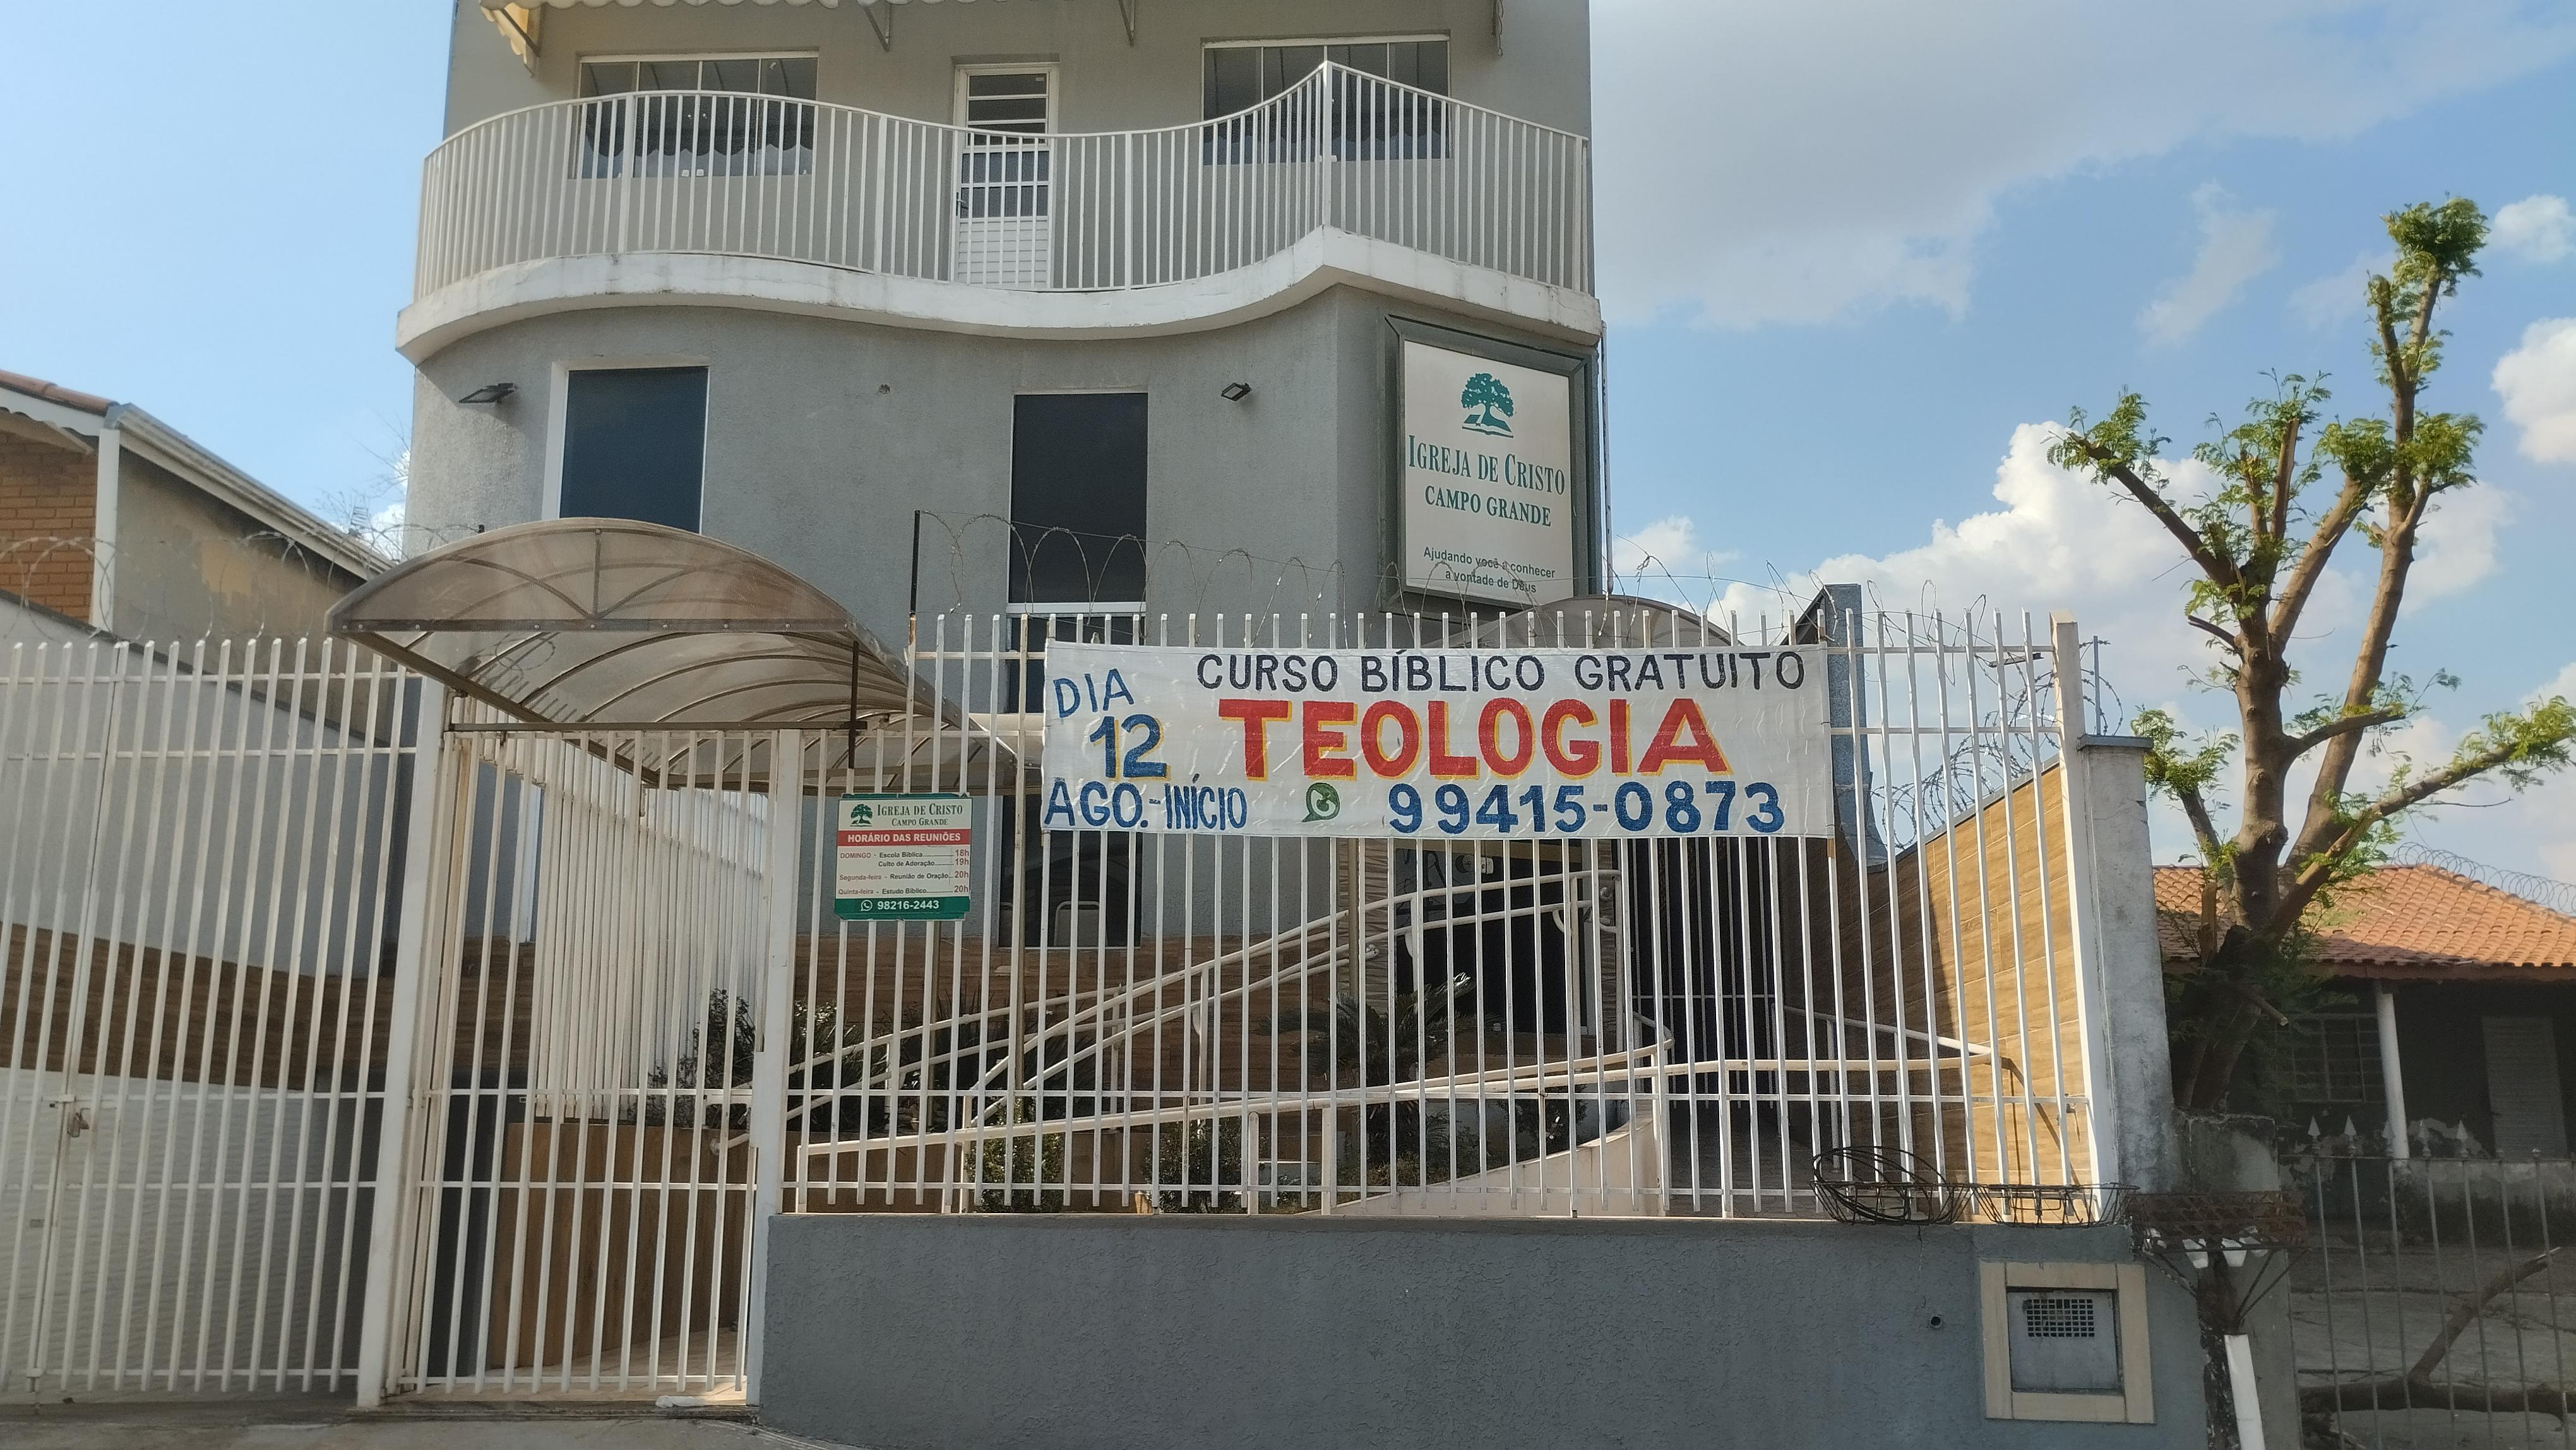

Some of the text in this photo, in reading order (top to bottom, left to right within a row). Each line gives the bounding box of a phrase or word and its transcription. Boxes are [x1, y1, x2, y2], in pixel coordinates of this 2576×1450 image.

[1409, 434, 1565, 495] IGREJA DE CRISTO
[1425, 485, 1551, 527] CAMPO GRANDE
[1424, 546, 1472, 564] Ajudando
[1475, 558, 1499, 569] você
[1511, 563, 1556, 578] conhecer
[1445, 570, 1451, 580] a
[1454, 572, 1494, 586] vontade
[1497, 577, 1509, 589] de
[1197, 649, 1804, 693] CURSO BÍBLICO GRATUITO
[1052, 668, 1135, 719] DIA
[1088, 713, 1172, 782] 12
[1218, 697, 1734, 782] TEOLOGIA
[877, 803, 963, 816] IGREJA DE CRISTO
[891, 817, 949, 827] CAMPO GRANDE
[1388, 781, 1785, 834] 99415-0873
[847, 831, 961, 843] HORÁRIO DAS REUNIÕES
[955, 849, 970, 857] 18h
[839, 874, 882, 882] Segunda-feira
[877, 900, 939, 910] 98216-2443
